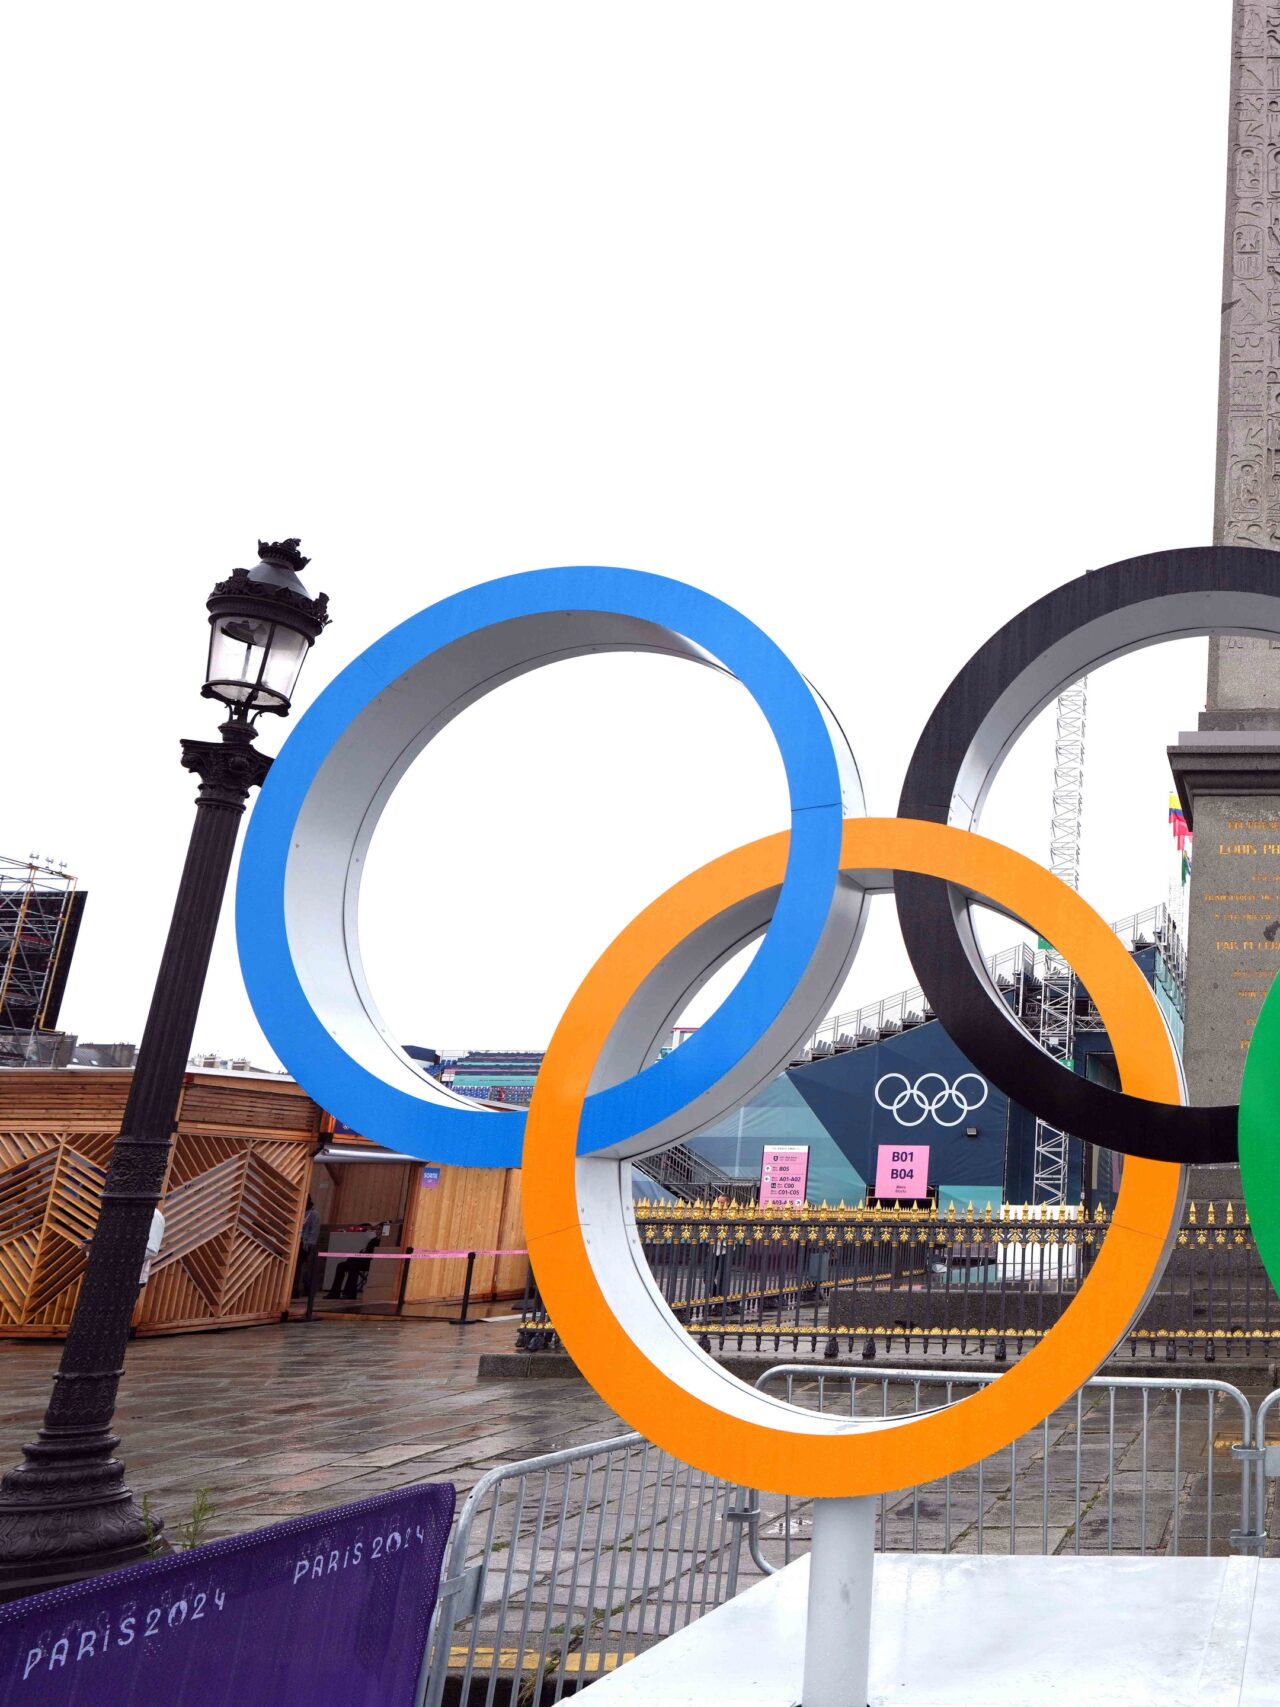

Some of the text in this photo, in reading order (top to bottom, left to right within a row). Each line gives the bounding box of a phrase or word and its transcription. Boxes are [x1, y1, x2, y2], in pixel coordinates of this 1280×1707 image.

[1218, 843, 1257, 855] LOUIS
[892, 1151, 914, 1162] B01
[891, 1168, 914, 1180] B04
[144, 1588, 226, 1637] 2024
